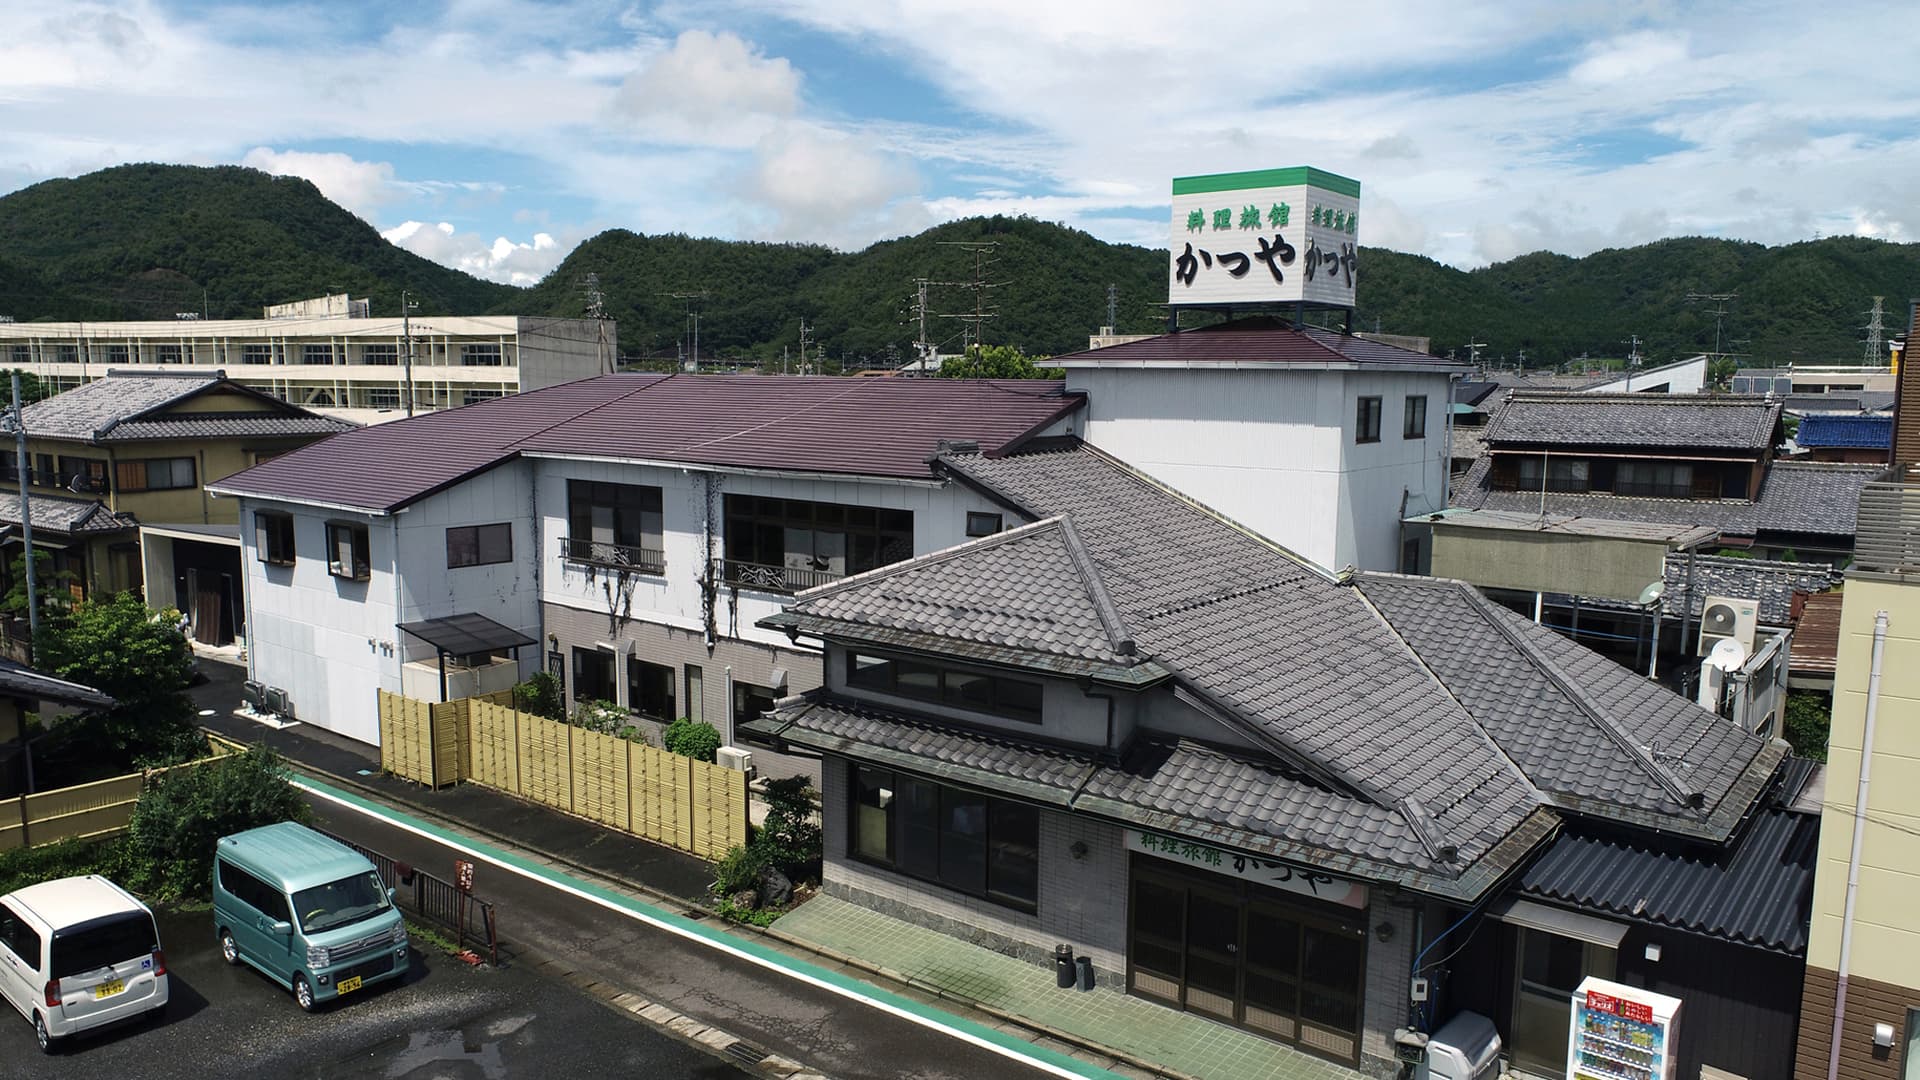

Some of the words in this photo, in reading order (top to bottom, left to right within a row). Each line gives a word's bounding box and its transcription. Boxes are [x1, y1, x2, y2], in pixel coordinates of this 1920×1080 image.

[1186, 202, 1291, 233] 料理旅館
[1176, 234, 1296, 286] かつや
[1304, 237, 1357, 288] かつや
[1141, 832, 1222, 867] 料理旅館
